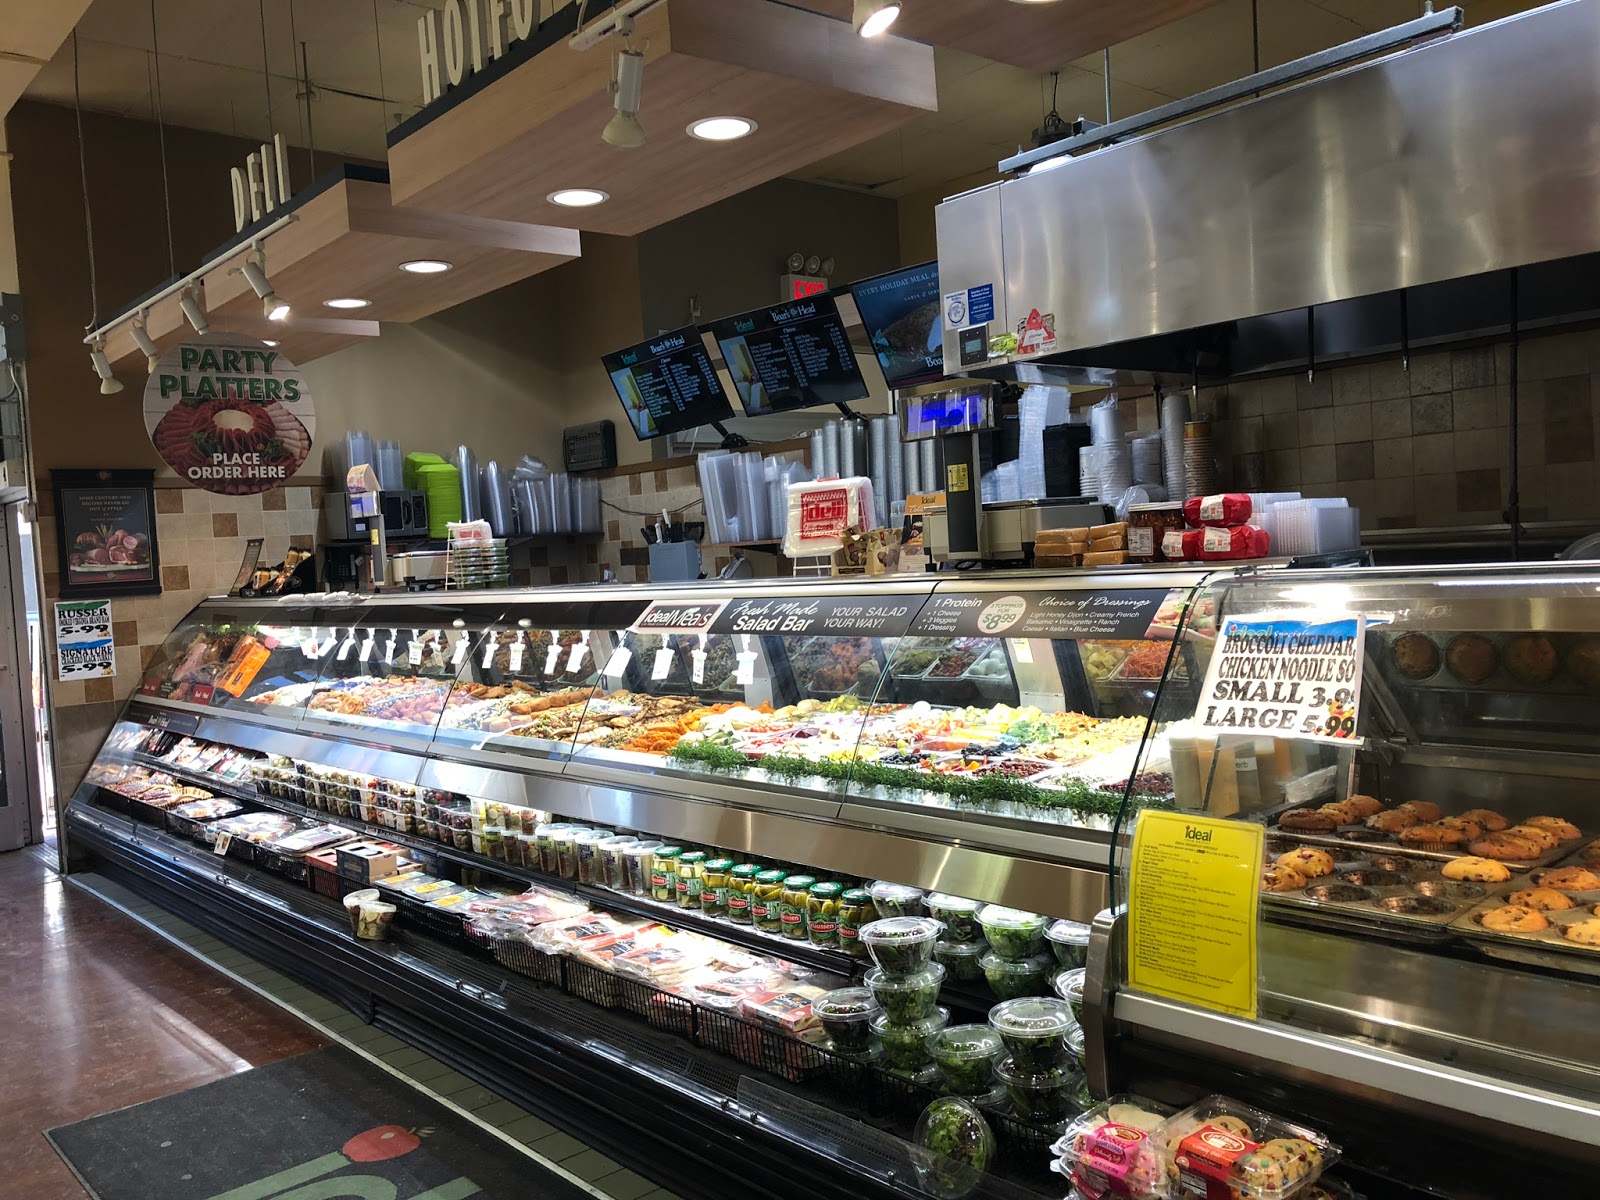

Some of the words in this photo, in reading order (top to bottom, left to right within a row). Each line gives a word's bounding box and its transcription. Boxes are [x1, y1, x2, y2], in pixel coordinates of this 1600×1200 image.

[230, 133, 289, 233] DELI
[858, 286, 879, 297] EVERY
[879, 278, 909, 292] HOLIDAY
[910, 273, 930, 284] MEAL
[797, 302, 816, 316] Head
[670, 335, 686, 348] Head
[180, 347, 278, 374] PARTY
[925, 355, 943, 369] Boa
[159, 374, 301, 402] PLATTERS
[213, 452, 261, 465] PLACE
[187, 466, 243, 479] ORDER
[250, 466, 286, 478] HERE
[729, 600, 770, 619] Fresh
[772, 600, 820, 616] Made
[934, 599, 940, 608] 1
[941, 598, 982, 608] Protein
[1038, 596, 1076, 607] Choice
[1078, 596, 1094, 610] of
[1093, 597, 1152, 610] Dressings
[58, 608, 108, 619] RUSSER
[831, 607, 862, 617] YOUR
[865, 606, 908, 617] SALAD
[732, 616, 783, 631] Salad
[780, 616, 815, 632] Bar
[823, 618, 857, 628] YOUR
[854, 618, 885, 628] WAY!
[928, 624, 956, 632] Dressing
[1222, 634, 1286, 654] BROCCOLI
[60, 646, 113, 658] SIGNATURE
[1218, 656, 1279, 680] CHICKEN
[1276, 657, 1336, 682] NOODLE
[1212, 680, 1304, 704] SMALL
[1308, 687, 1355, 708] 3.9
[1203, 706, 1298, 730] LARGE
[1300, 715, 1355, 739] 5.99
[1185, 824, 1212, 842] ideal
